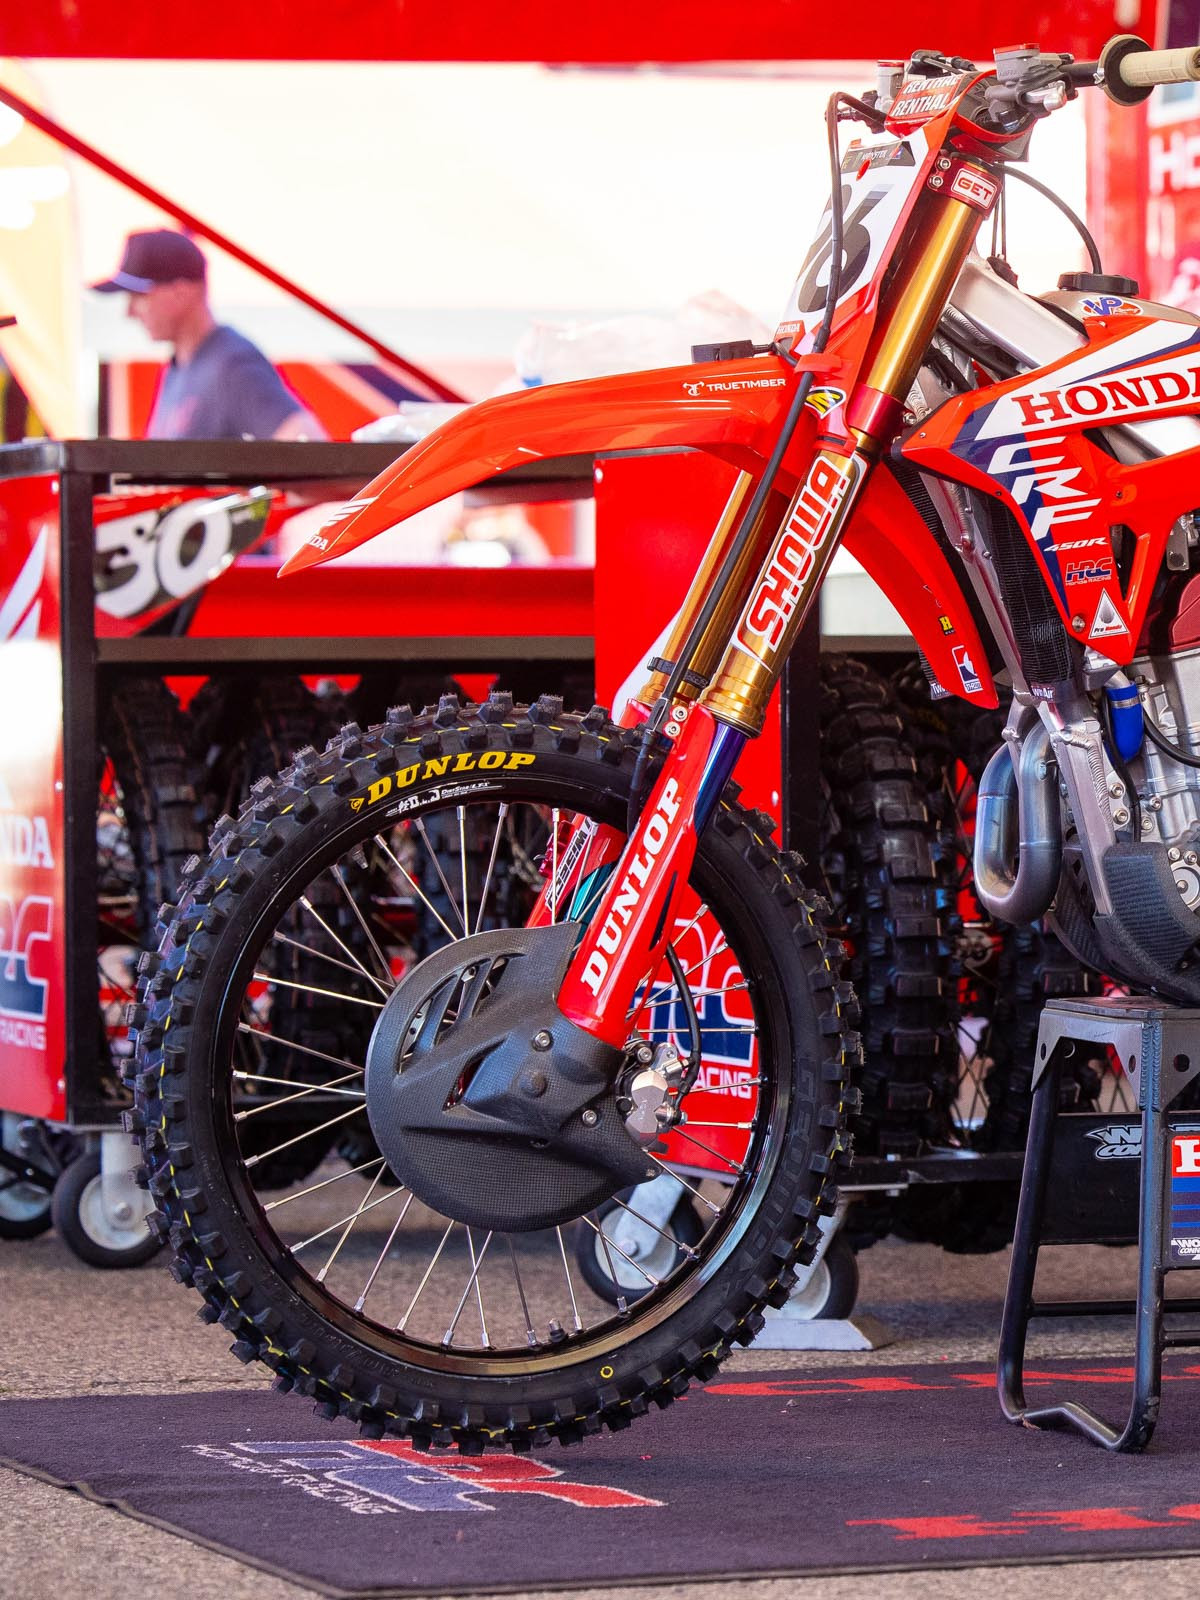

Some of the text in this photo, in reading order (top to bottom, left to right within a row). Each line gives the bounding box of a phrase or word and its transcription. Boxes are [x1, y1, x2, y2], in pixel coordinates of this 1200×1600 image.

[902, 74, 961, 93] RENTHAL
[892, 93, 951, 116] RENTHAL
[957, 176, 993, 201] GET
[1080, 297, 1123, 316] VP
[707, 378, 786, 392] TRUETIMBER
[746, 456, 851, 652] SHOWA
[1043, 537, 1109, 552] 450R
[95, 498, 232, 619] 30
[1066, 557, 1113, 582] HRC
[367, 751, 536, 805] DUNLOP
[581, 777, 679, 997] DUNLOP
